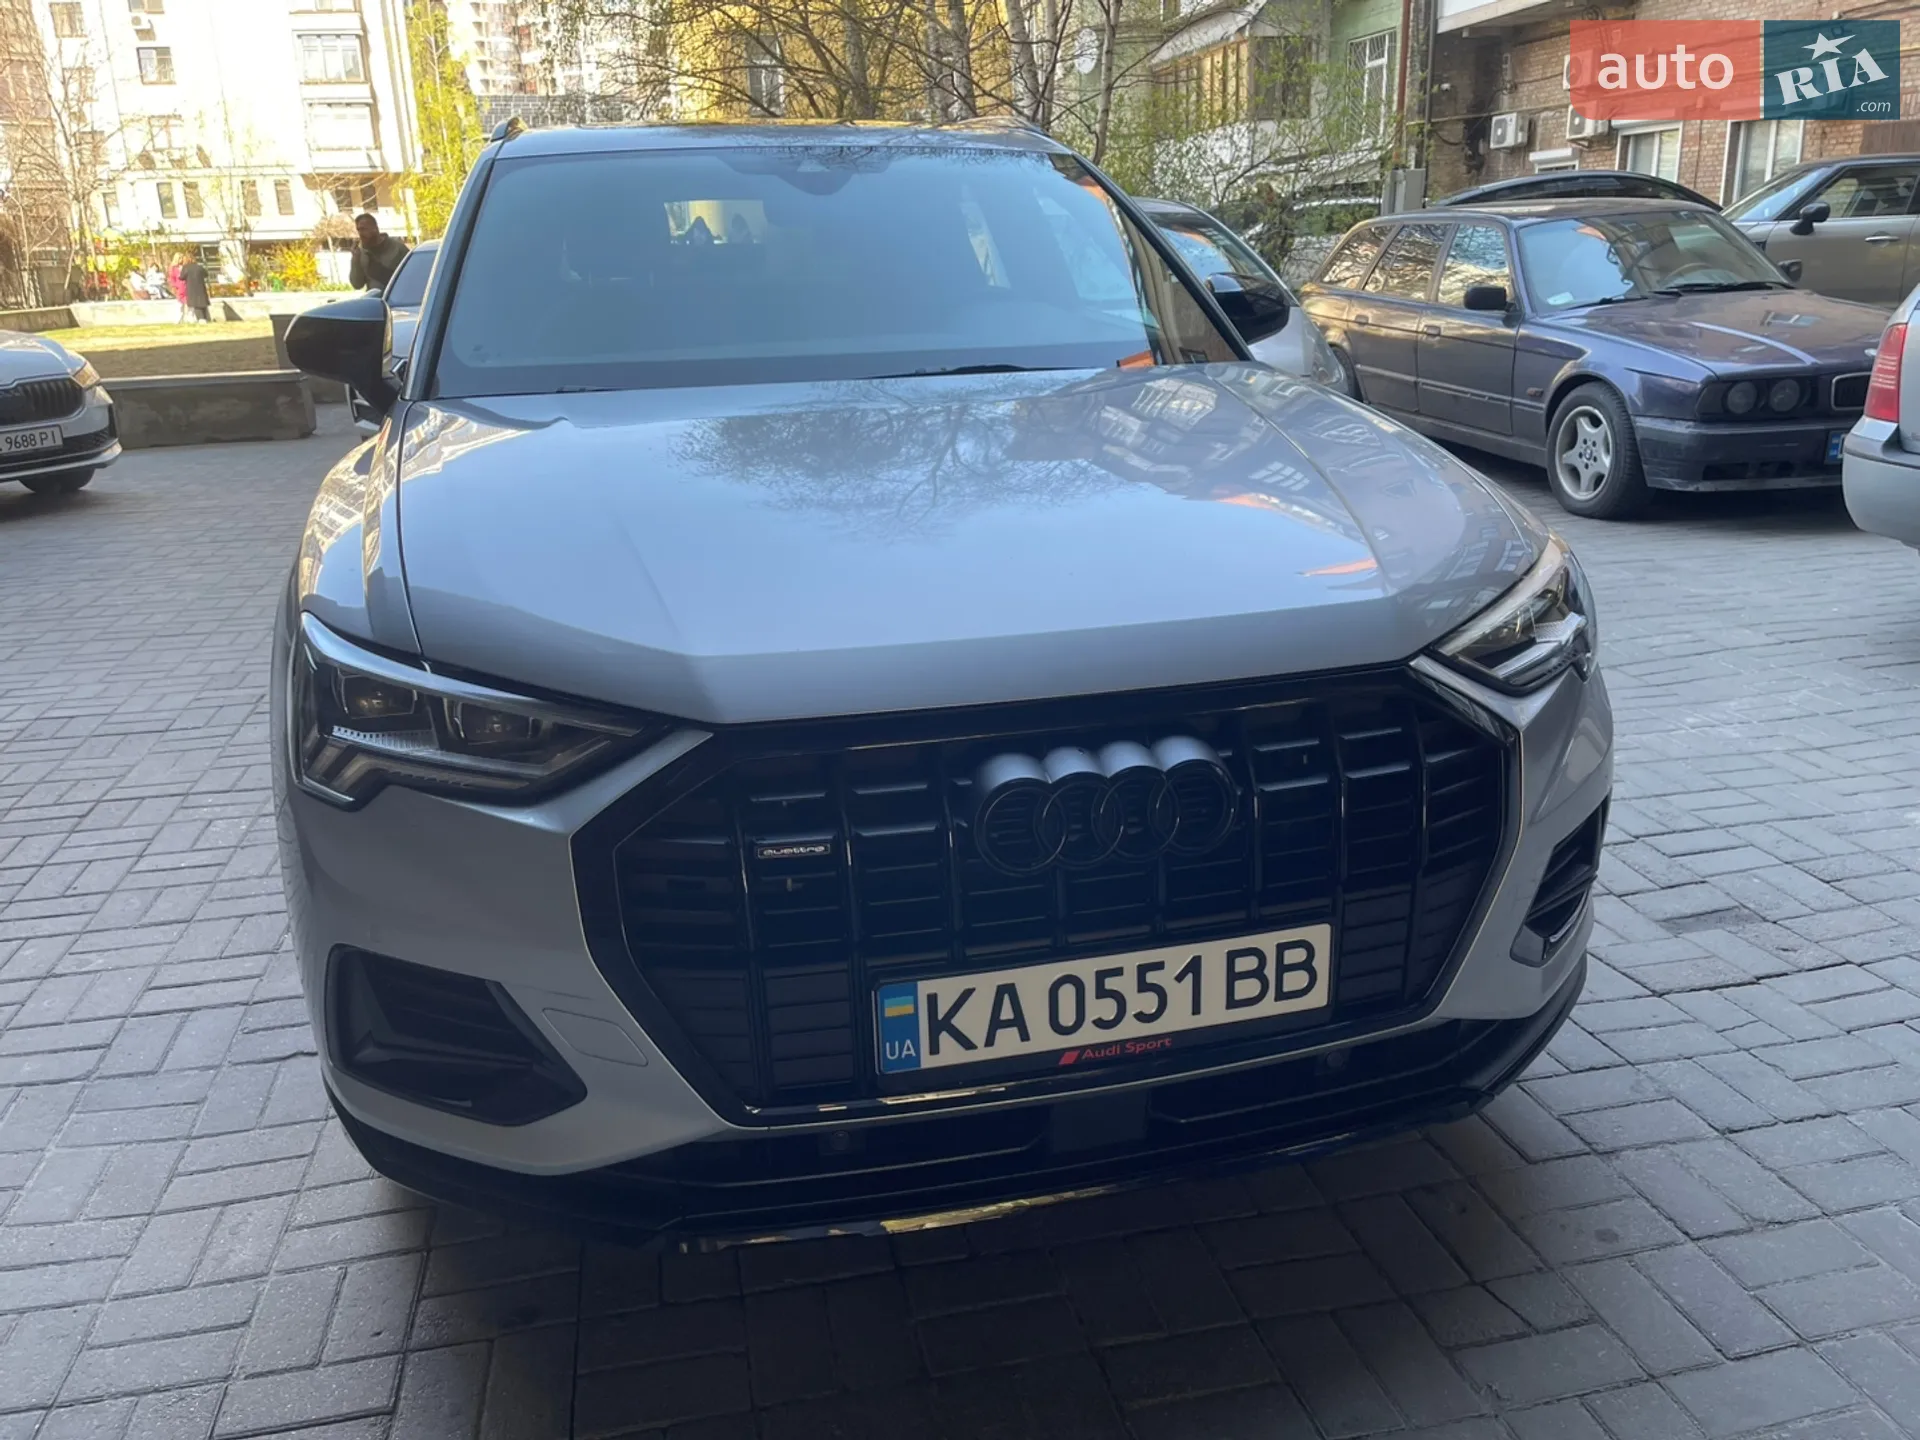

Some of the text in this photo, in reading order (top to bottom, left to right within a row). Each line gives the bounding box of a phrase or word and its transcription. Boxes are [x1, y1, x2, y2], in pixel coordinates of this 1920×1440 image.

[5, 433, 37, 451] 9688
[926, 938, 1318, 1056] KA 0551 BB
[885, 1038, 917, 1061] UA
[1081, 1036, 1173, 1061] Audi Sport
